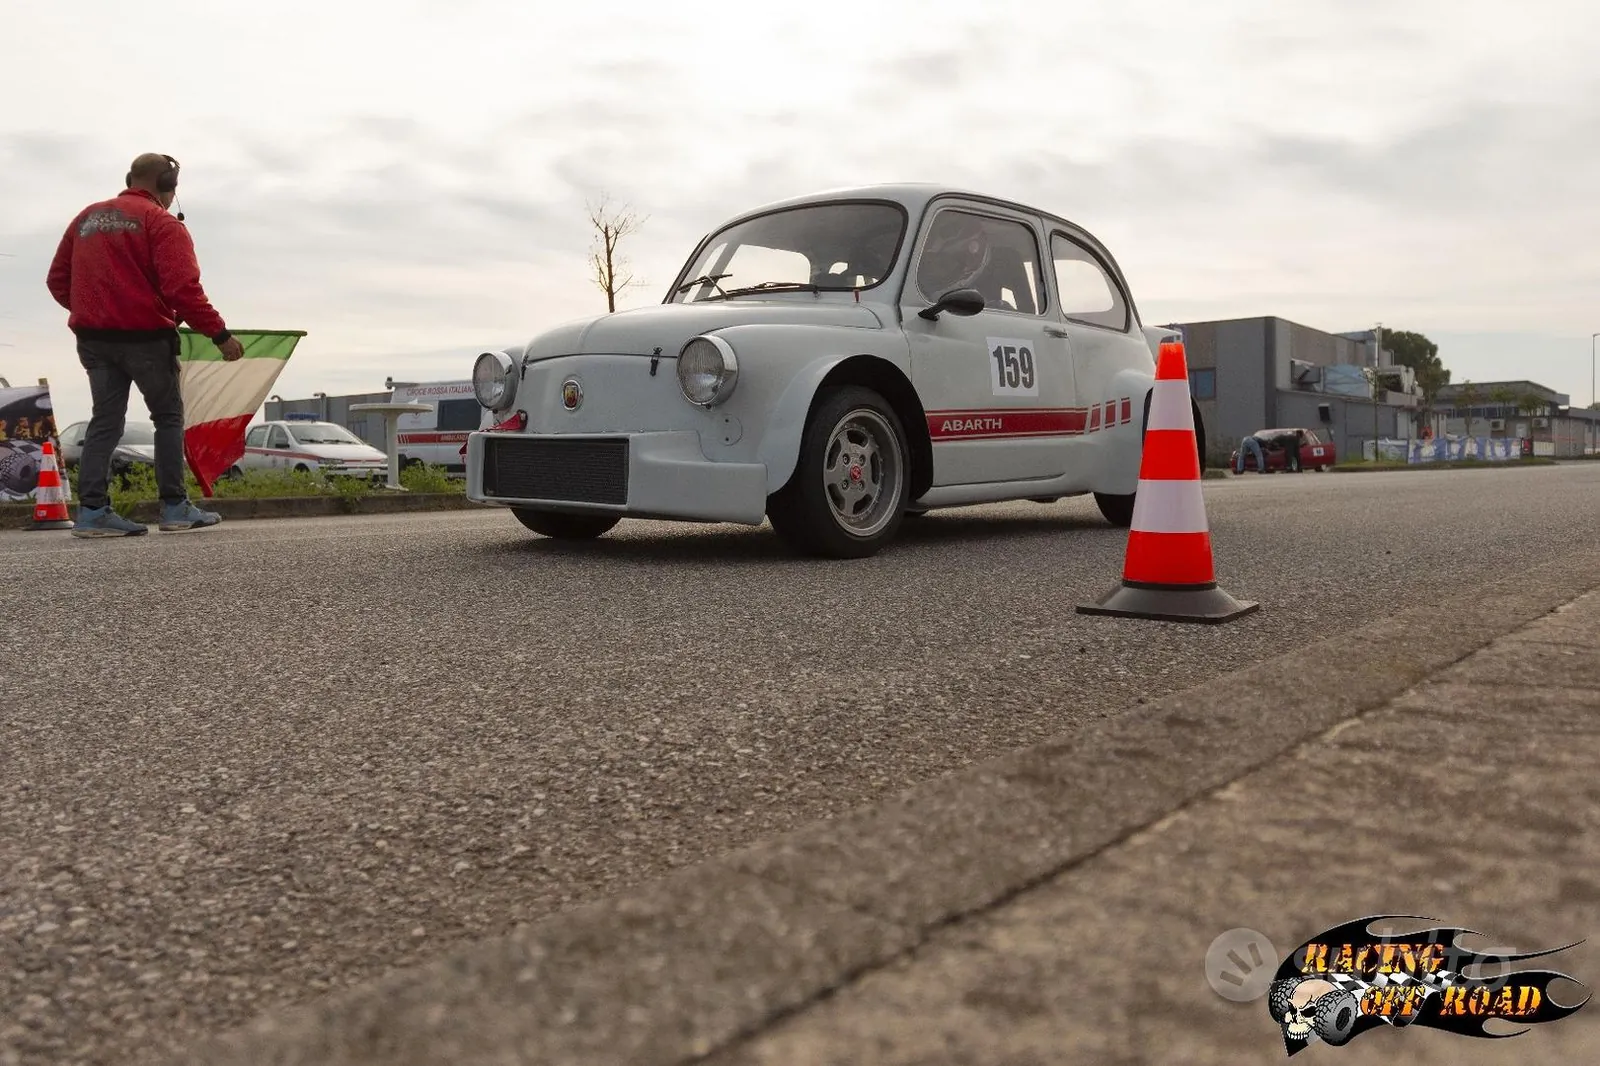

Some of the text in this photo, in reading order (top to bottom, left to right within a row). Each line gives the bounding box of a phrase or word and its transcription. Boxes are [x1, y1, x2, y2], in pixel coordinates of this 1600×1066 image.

[992, 345, 1035, 389] 159
[406, 387, 426, 396] CROCE
[427, 386, 448, 395] ROSSA
[941, 418, 1003, 432] ABARTH
